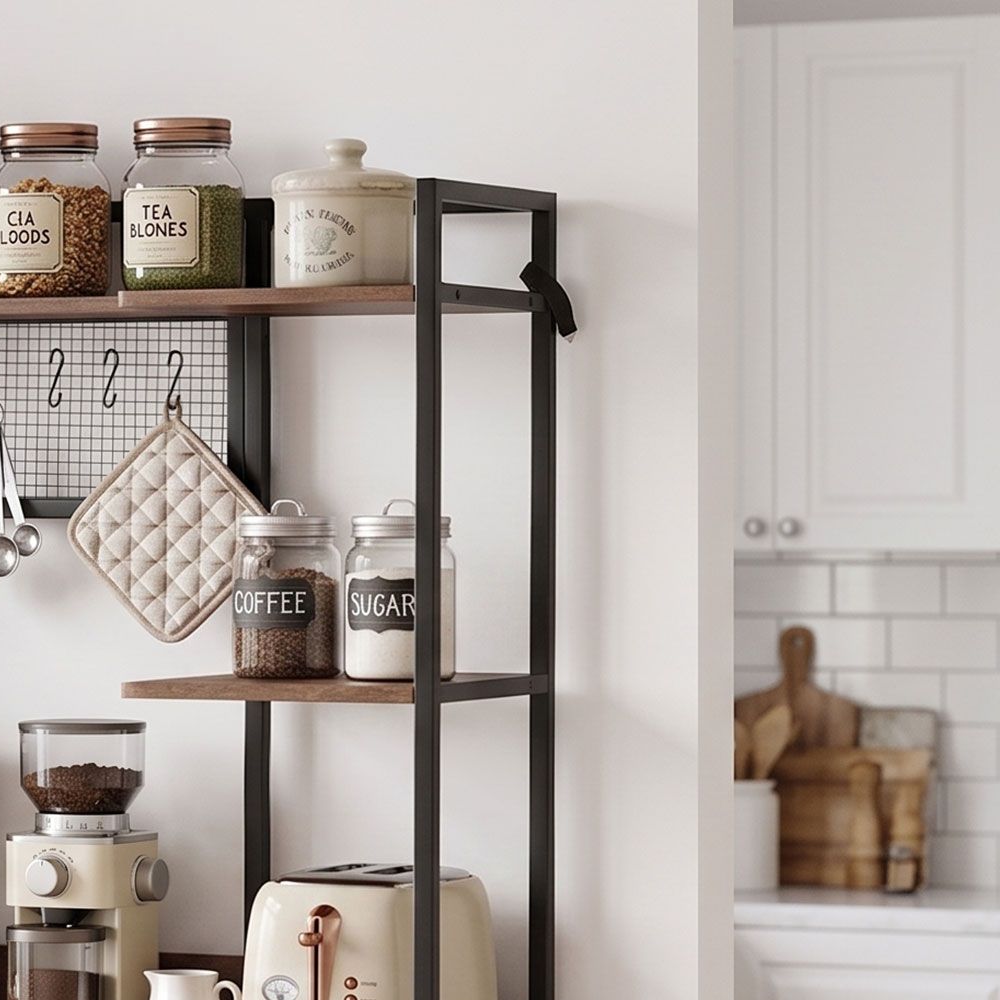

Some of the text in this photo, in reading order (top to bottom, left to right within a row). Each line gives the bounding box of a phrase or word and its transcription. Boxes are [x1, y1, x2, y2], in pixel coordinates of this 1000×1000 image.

[142, 204, 172, 220] TEA
[130, 221, 188, 238] BLONES
[234, 591, 307, 614] COFFEE
[351, 592, 415, 617] SUGAR
